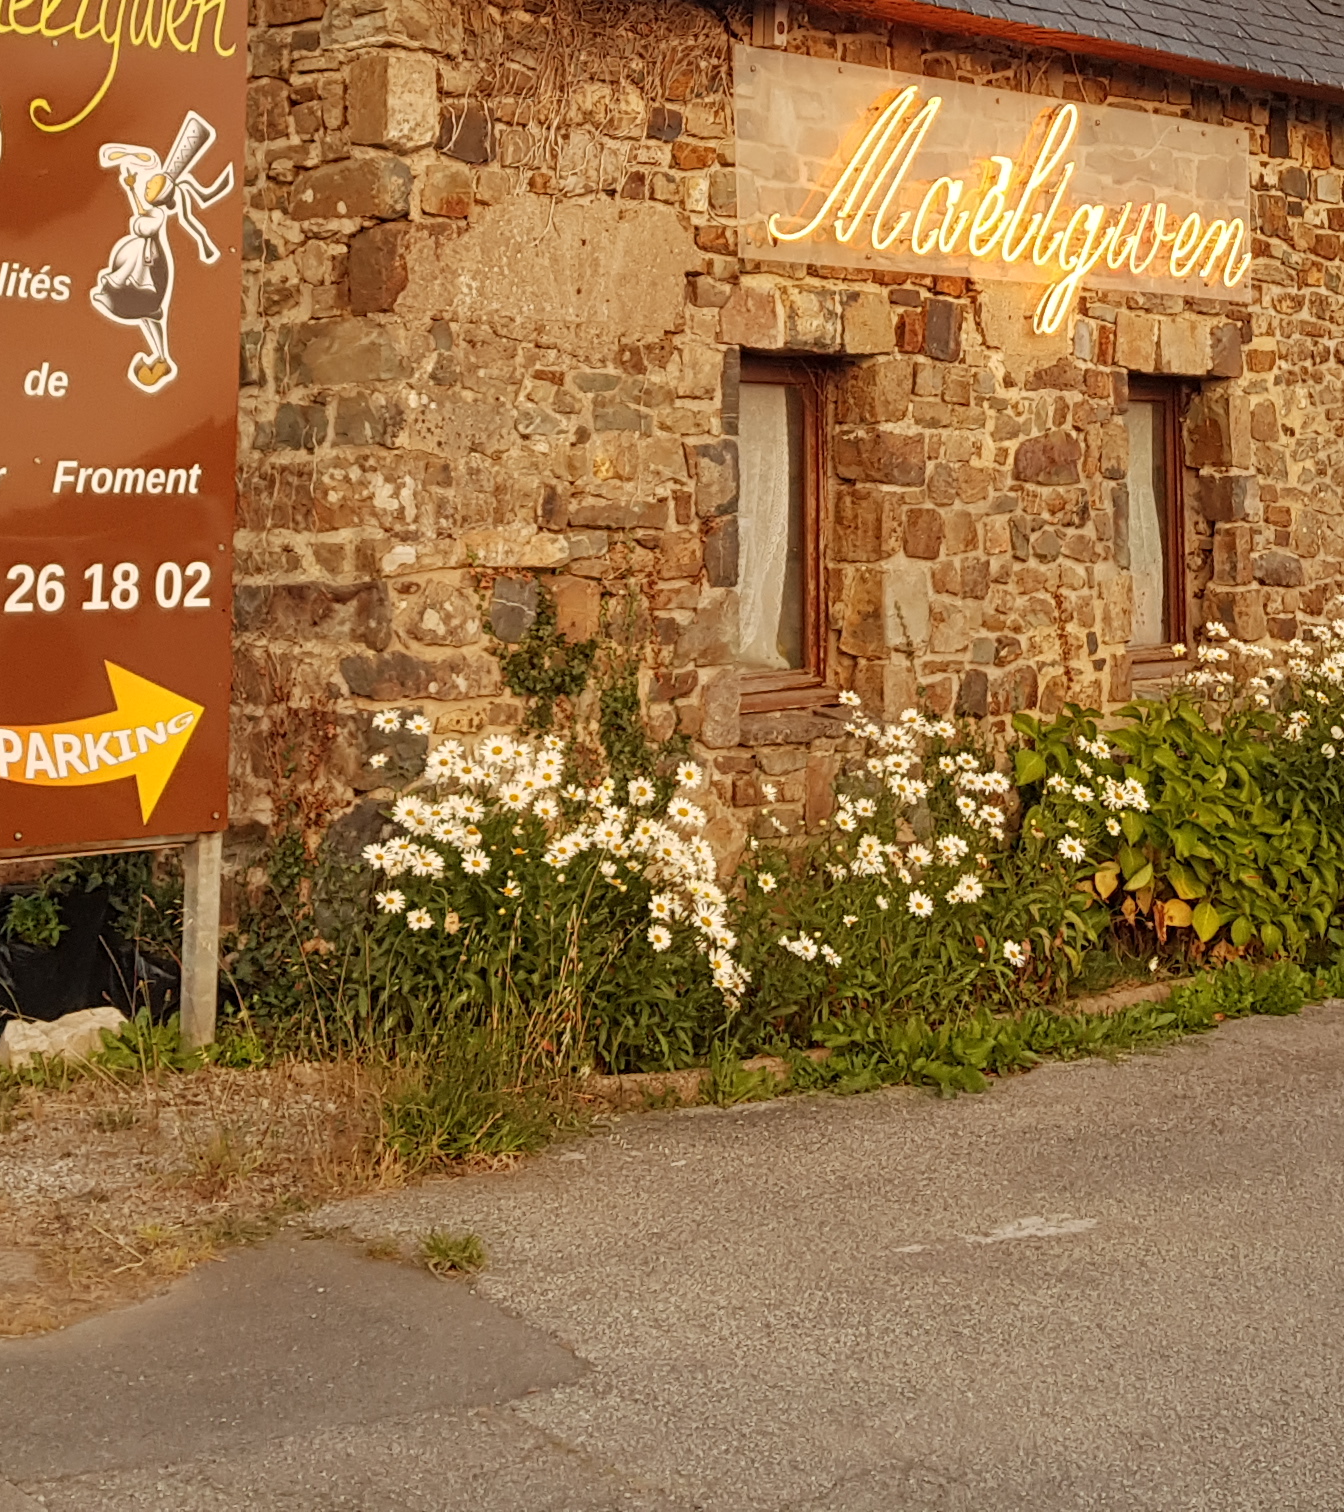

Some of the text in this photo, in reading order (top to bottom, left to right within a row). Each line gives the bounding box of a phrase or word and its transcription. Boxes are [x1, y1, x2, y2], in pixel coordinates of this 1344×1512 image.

[23, 362, 69, 397] de
[52, 460, 202, 494] Froment
[3, 564, 66, 613] 26
[82, 562, 140, 610] 18
[155, 561, 212, 609] 02
